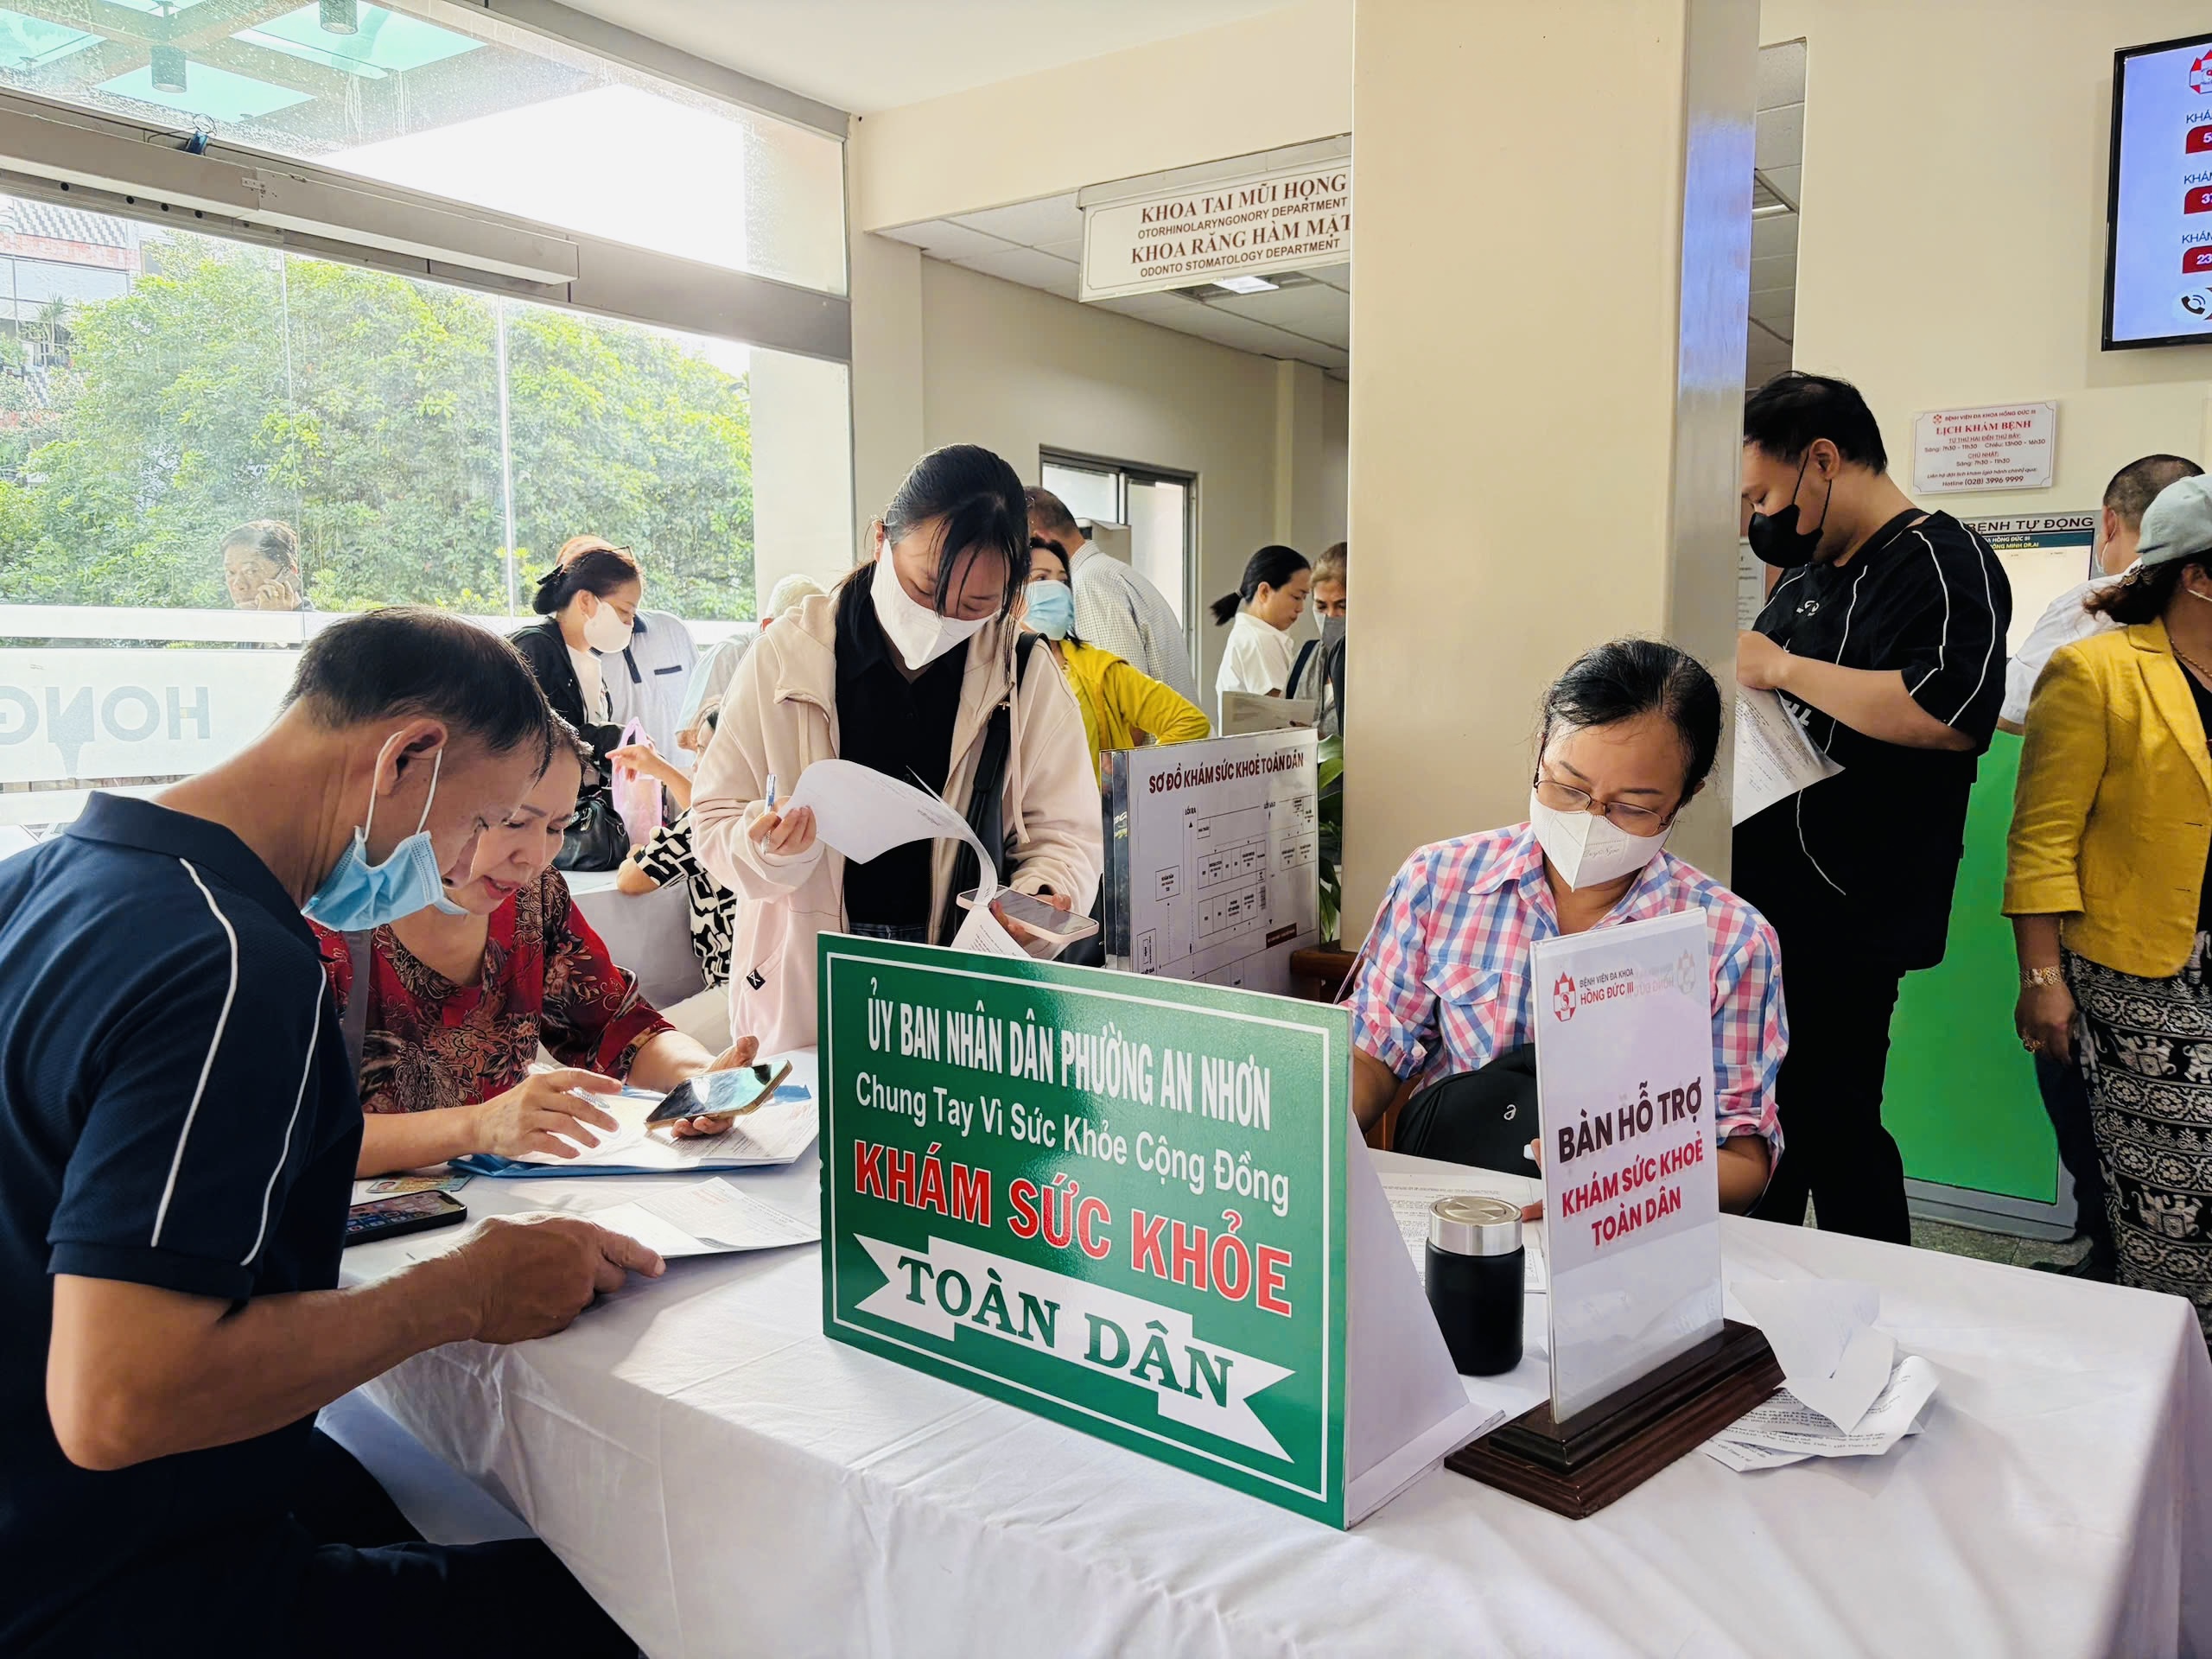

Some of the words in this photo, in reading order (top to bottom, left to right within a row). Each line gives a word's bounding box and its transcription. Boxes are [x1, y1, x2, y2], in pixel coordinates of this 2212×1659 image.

[2186, 109, 2212, 124] KHÁ
[1141, 200, 1197, 224] KHOA
[1202, 194, 1233, 214] TAI
[1238, 182, 1277, 207] MŨI
[1284, 174, 1346, 200] HỌNG
[2183, 170, 2212, 185] KHÁ
[1131, 241, 1186, 264] KHOA
[1192, 231, 1246, 256] RĂNG
[1253, 220, 1300, 245] HÀM
[1306, 213, 1351, 238] MẶT
[1138, 209, 1269, 239] OTORHINOLARYNGONORY
[1272, 197, 1348, 218] DEPARTMENT
[1141, 263, 1183, 277] ODONTO
[1185, 250, 1263, 270] STOMATOLOGY
[1266, 238, 1340, 258] DEPARTMENT
[1936, 426, 1961, 435] LỊCH
[1965, 421, 1999, 432] KHÁM
[2001, 419, 2031, 430] BỆNH
[1964, 477, 1983, 486] (028)
[1148, 772, 1165, 794] SƠ
[1166, 762, 1182, 791] ĐỒ
[1184, 761, 1214, 788] KHÁM
[1215, 758, 1234, 782] SỨC
[1262, 751, 1286, 774] TOÀN
[1286, 749, 1304, 771] DÂN
[1579, 978, 1595, 988] BỆNH
[1596, 974, 1609, 985] VIỆN
[1610, 972, 1618, 981] ĐA
[1618, 968, 1634, 979] KHOA
[1580, 988, 1605, 1006] HỒNG
[1607, 981, 1625, 999] ĐỨC
[868, 976, 893, 1052] ỦY
[899, 1002, 940, 1062] BAN
[946, 1000, 1002, 1074] NHÂN
[1009, 1007, 1054, 1084] DÂN
[1061, 1021, 1154, 1107] PHƯỜNG
[1160, 1048, 1192, 1114] AN
[1201, 1053, 1270, 1131] NHƠN
[1558, 1108, 1613, 1164] BÀN
[1618, 1080, 1654, 1141] HỖ
[1656, 1076, 1702, 1125] TRỢ
[855, 1071, 927, 1128] Chung
[933, 1086, 974, 1137] Tay
[980, 1095, 1003, 1136] Vì
[1010, 1103, 1057, 1148] Sức
[1064, 1114, 1128, 1165] Khỏe
[1135, 1131, 1205, 1195] Cộng
[1213, 1147, 1289, 1217] Đồng
[1561, 1171, 1619, 1218] KHÁM
[1622, 1154, 1656, 1193] SỨC
[854, 1139, 991, 1229] KHÁM
[1007, 1172, 1112, 1261] SỨC
[1130, 1207, 1293, 1319] KHỎE
[1591, 1202, 1642, 1247] TOÀN
[1645, 1185, 1681, 1224] DÂN
[897, 1255, 1061, 1349] TOÀN
[1084, 1312, 1234, 1409] DÂN
